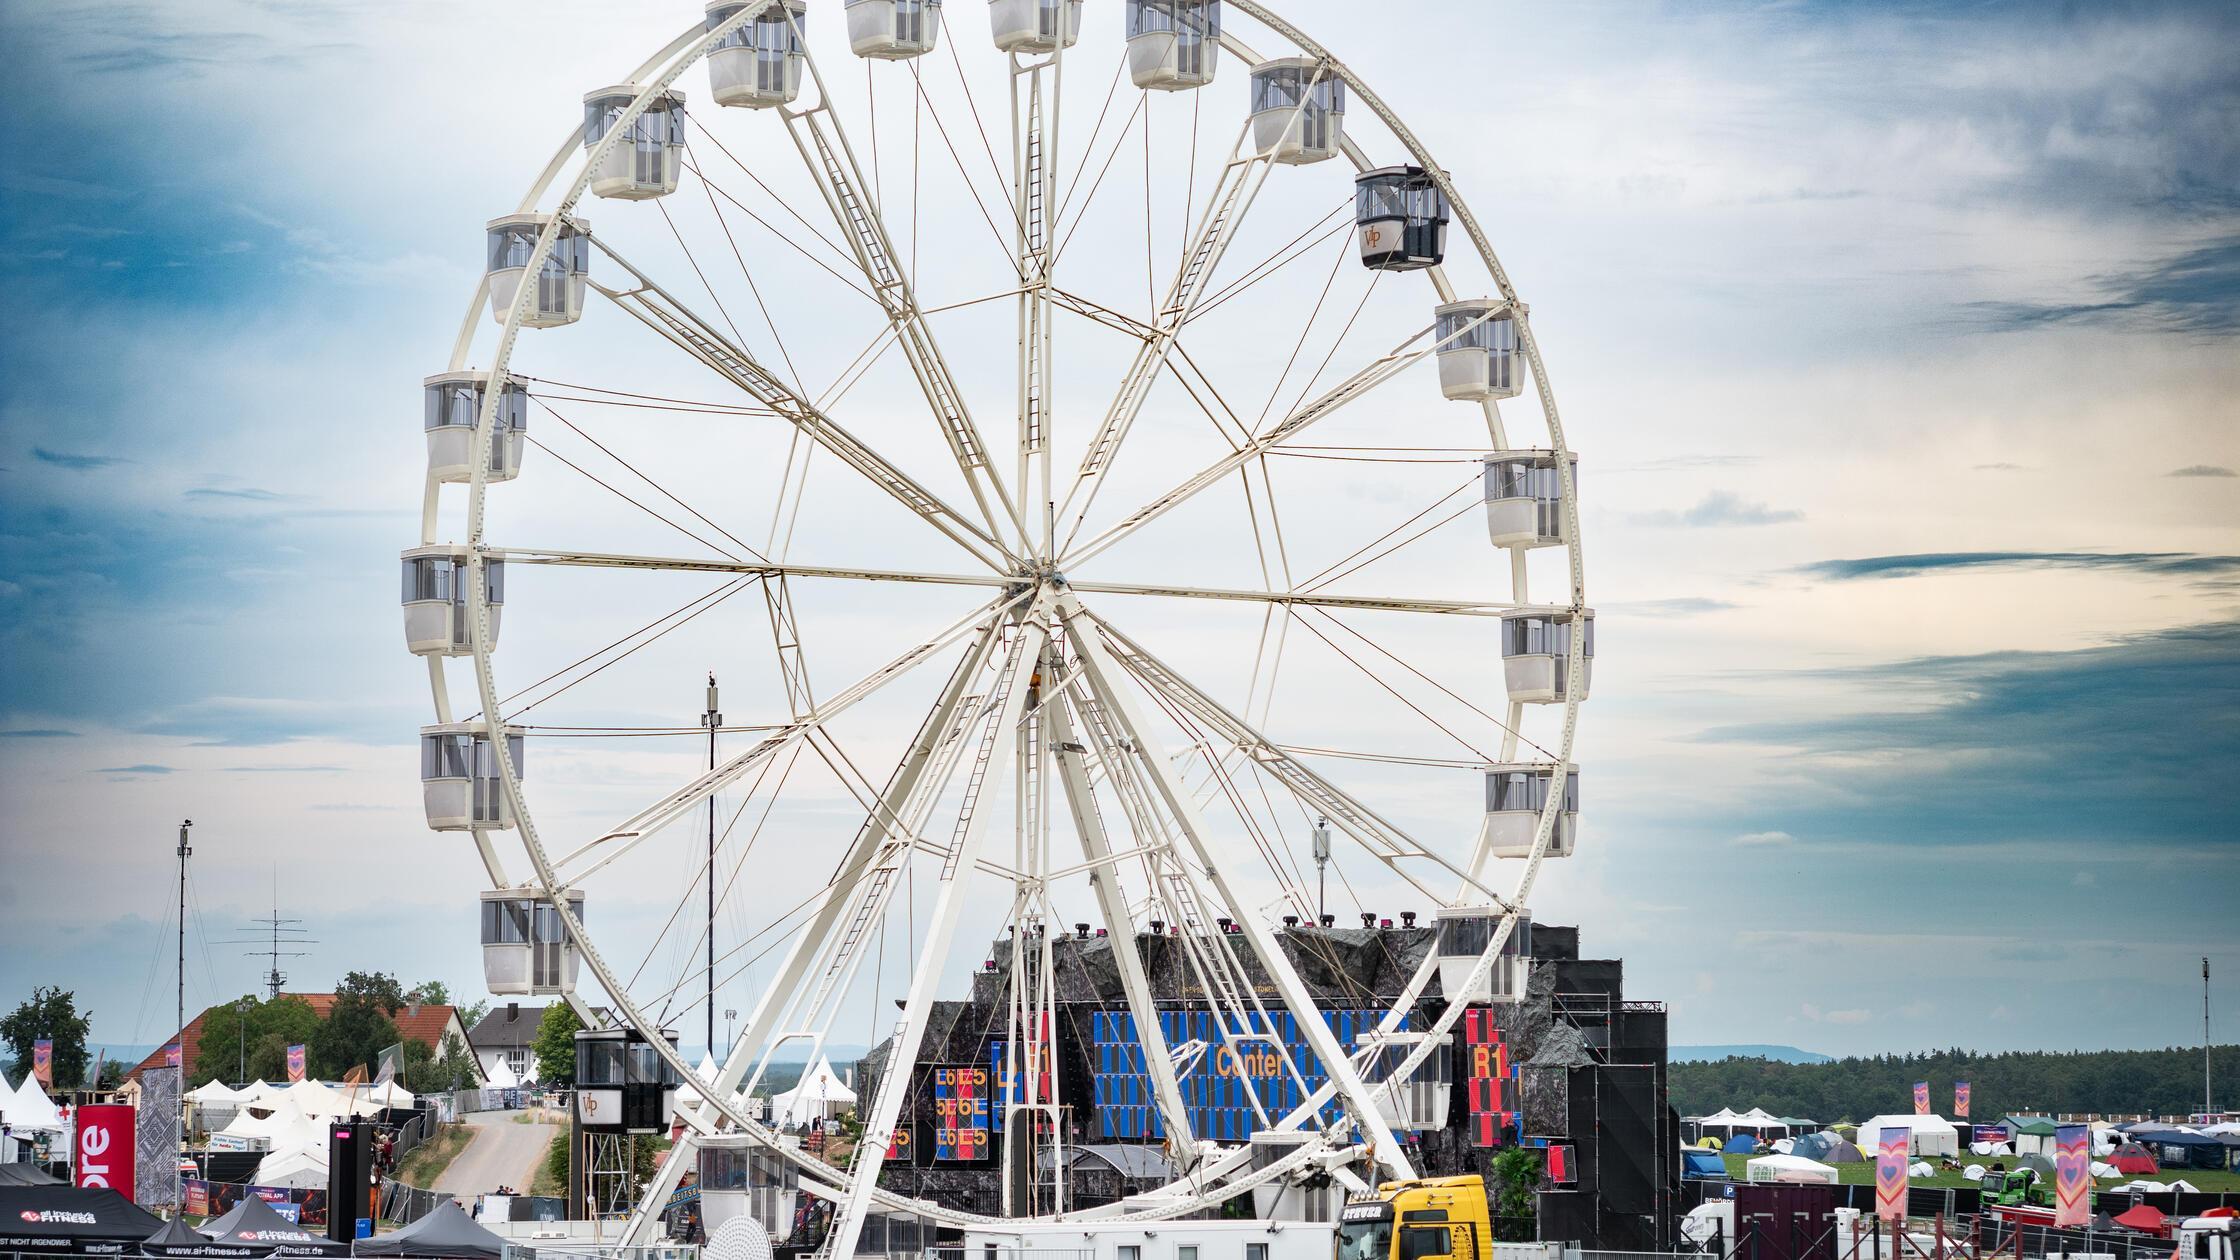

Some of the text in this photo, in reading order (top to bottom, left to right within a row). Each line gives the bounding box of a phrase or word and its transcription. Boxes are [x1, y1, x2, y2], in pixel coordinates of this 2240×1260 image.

[1474, 1047, 1501, 1078] R1
[41, 1215, 97, 1224] FITNESS
[166, 1246, 251, 1256] www.ai-fitness.de
